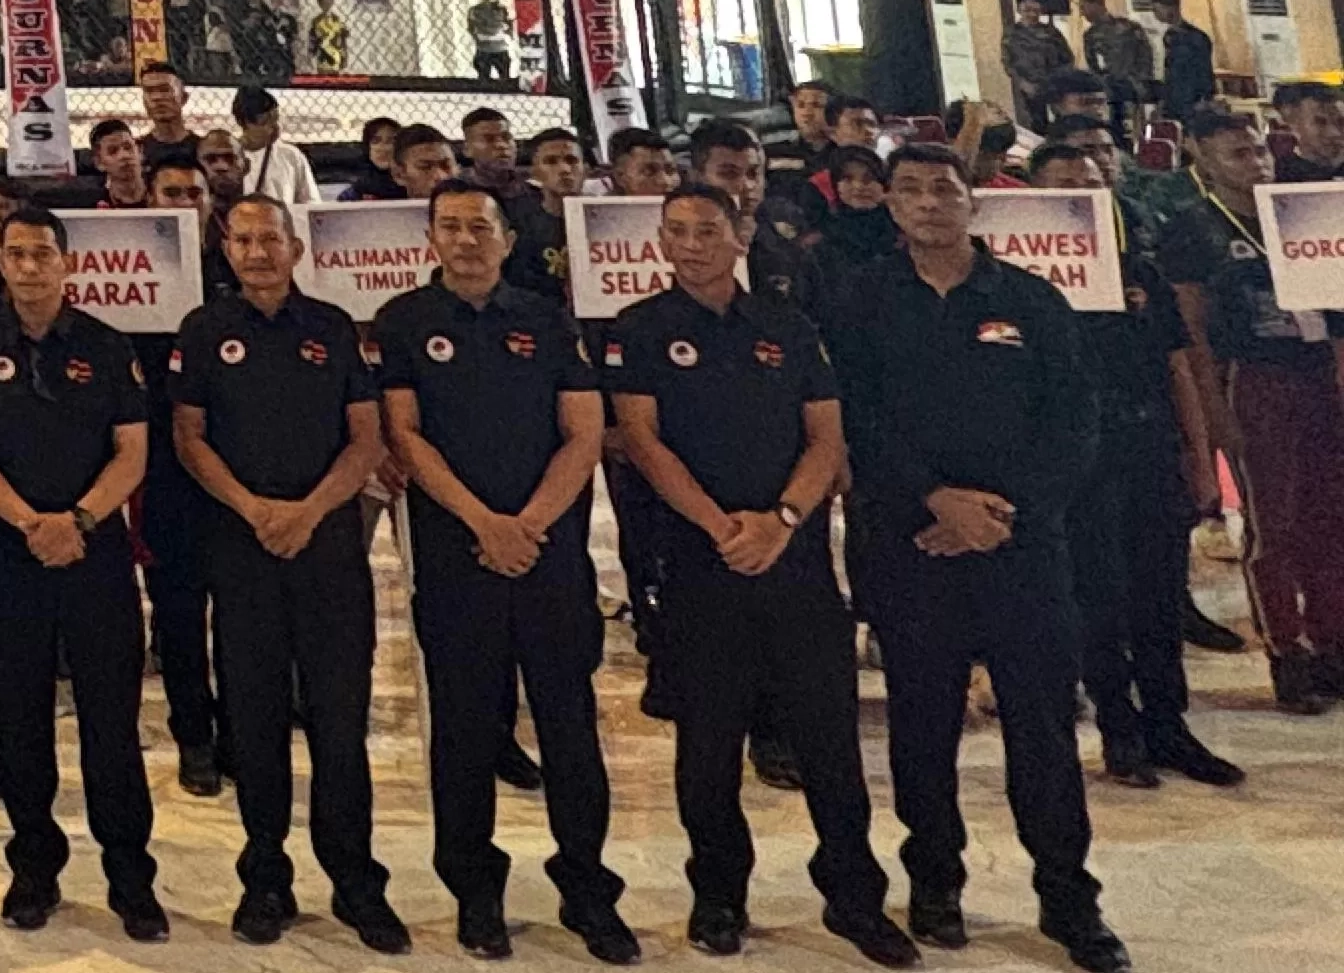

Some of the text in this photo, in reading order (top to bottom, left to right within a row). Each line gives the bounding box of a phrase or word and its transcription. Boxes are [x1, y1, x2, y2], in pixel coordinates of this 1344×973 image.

[590, 239, 665, 264] SULA
[988, 232, 1099, 258] LAWESI
[314, 247, 439, 269] KALIMANTA
[352, 271, 417, 290] TIMUR
[601, 271, 677, 295] SELAT
[64, 281, 160, 306] BARAT
